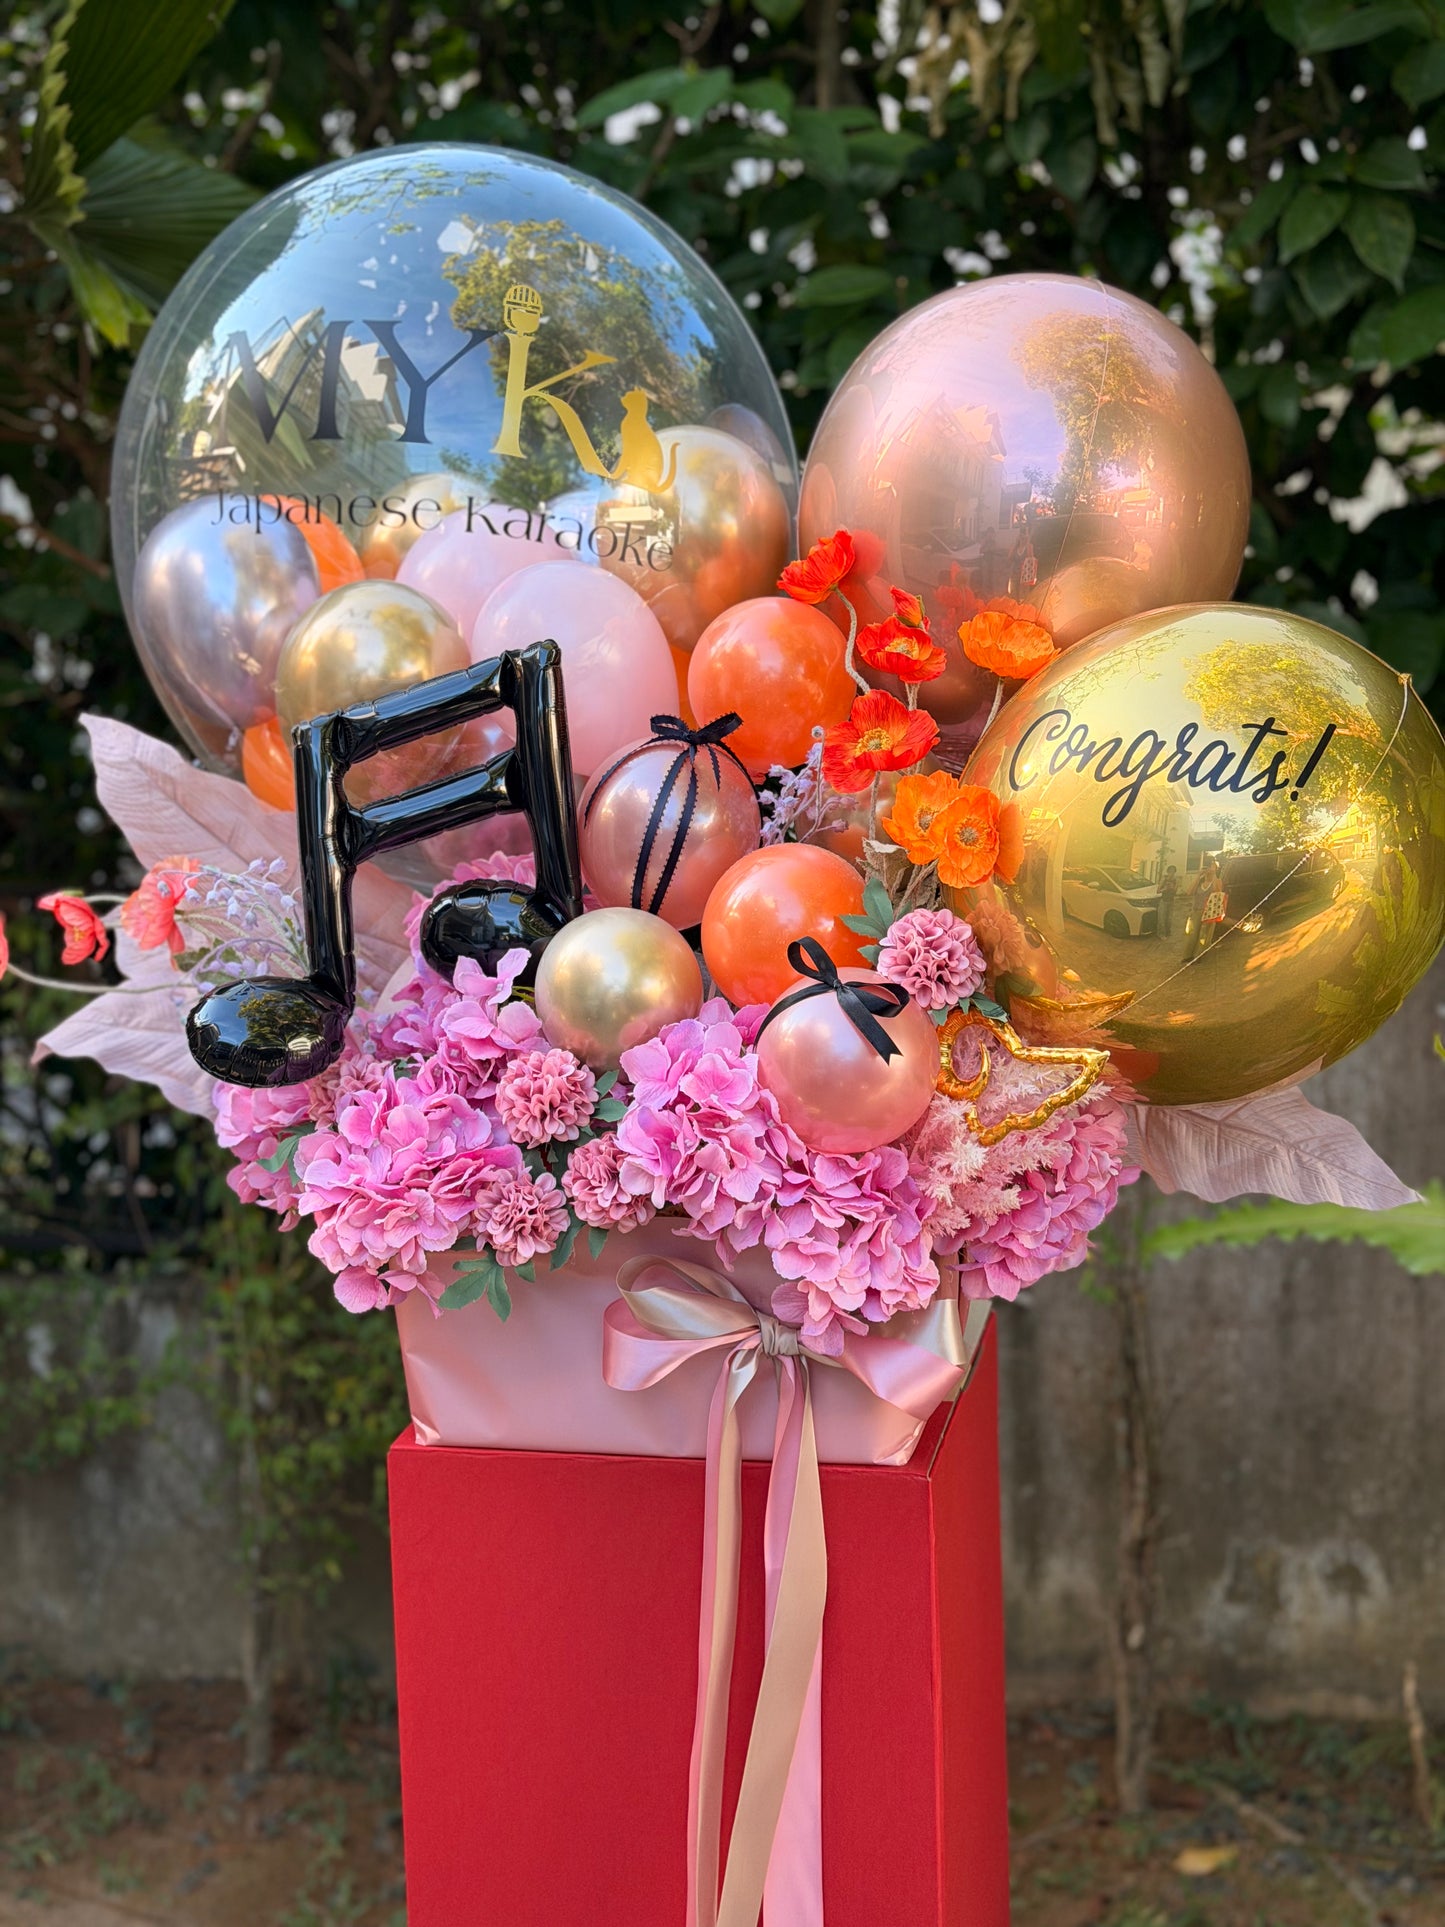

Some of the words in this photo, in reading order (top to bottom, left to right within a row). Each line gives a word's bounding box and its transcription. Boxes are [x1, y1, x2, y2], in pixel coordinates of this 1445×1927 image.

[211, 487, 444, 534] Japanese
[465, 496, 674, 572] Karaoke
[1008, 708, 1337, 828] Congrats!
